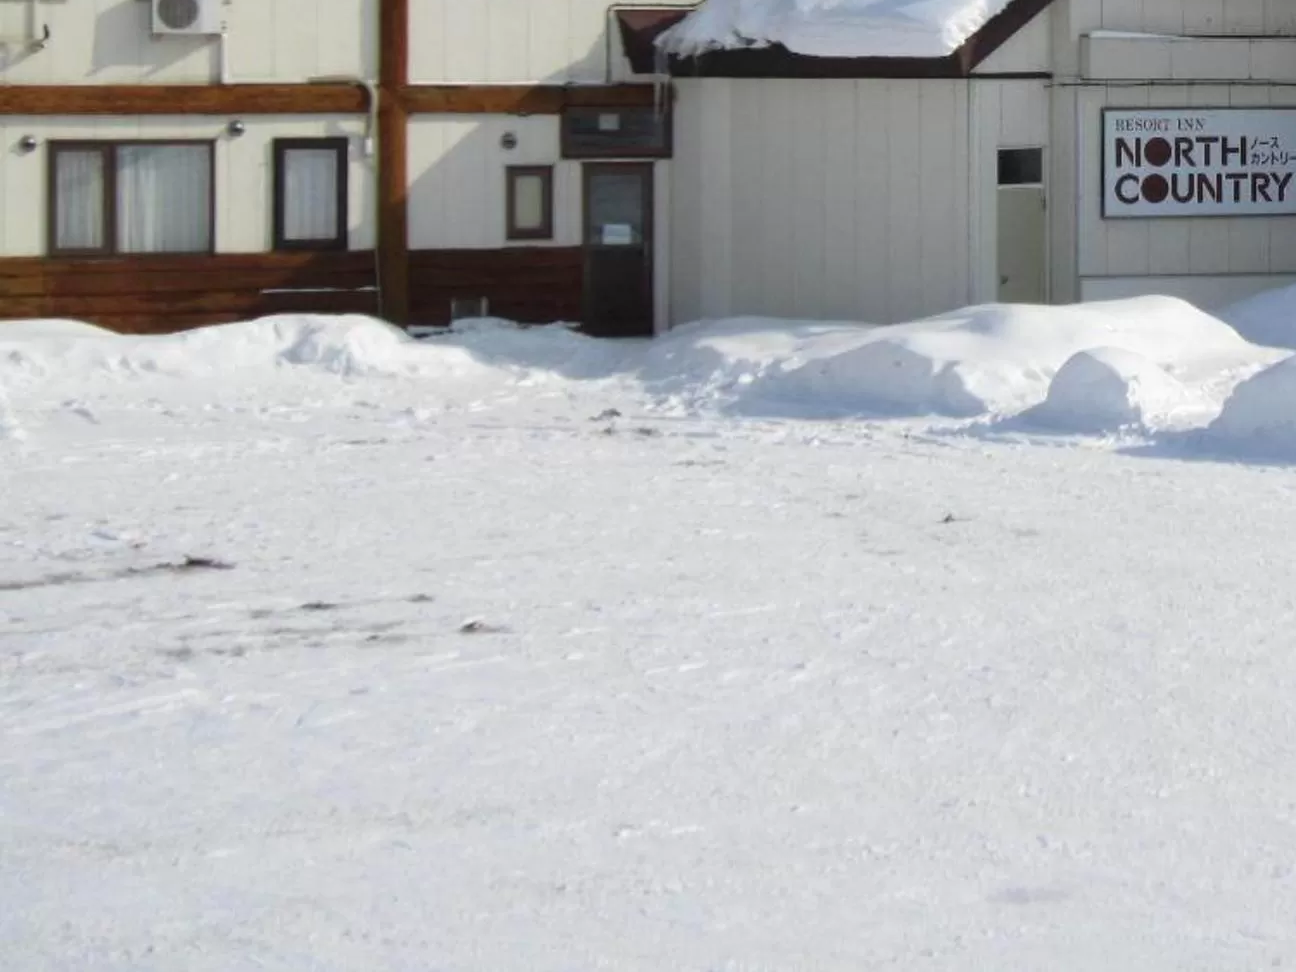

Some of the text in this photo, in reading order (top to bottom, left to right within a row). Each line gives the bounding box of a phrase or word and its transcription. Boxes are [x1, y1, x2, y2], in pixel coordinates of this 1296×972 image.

[1115, 118, 1206, 132] RESORT INN
[1115, 136, 1247, 167] NORTH
[1250, 136, 1279, 150] ノース
[1114, 172, 1293, 204] COUNTRY
